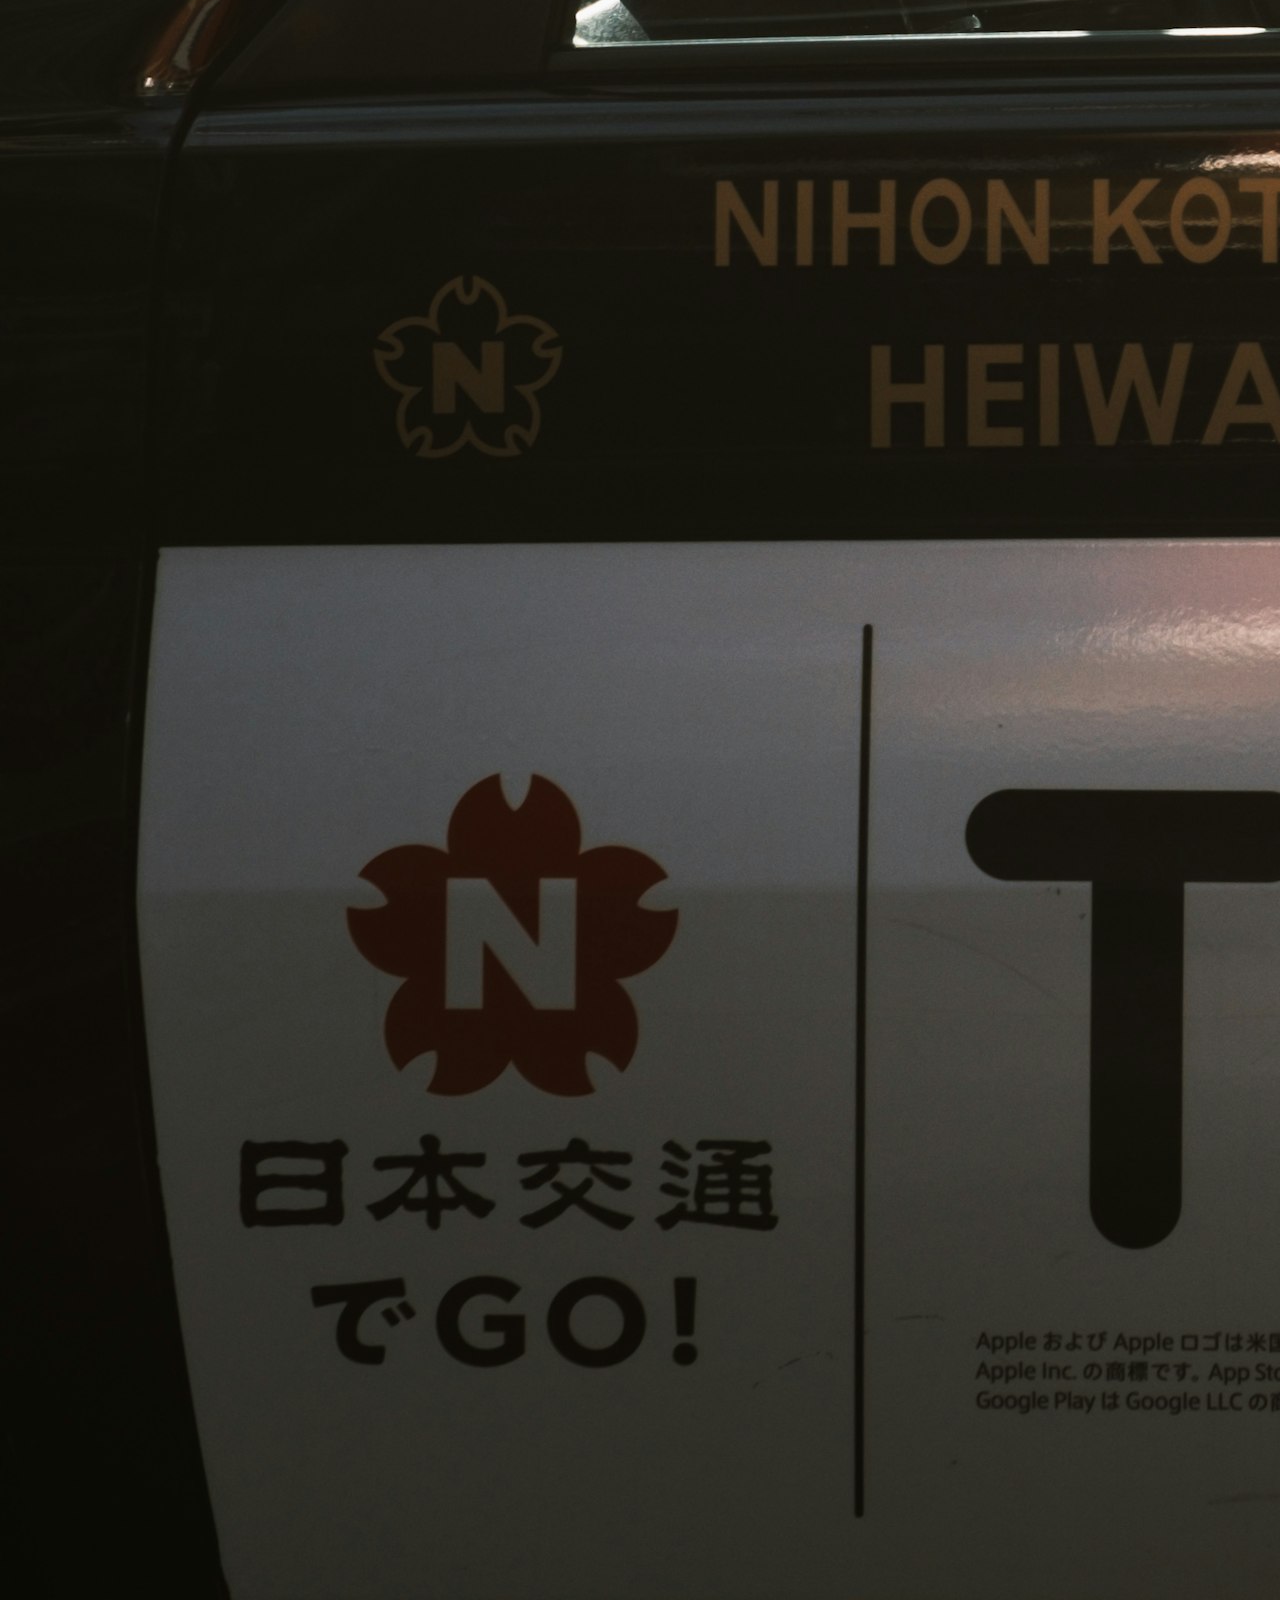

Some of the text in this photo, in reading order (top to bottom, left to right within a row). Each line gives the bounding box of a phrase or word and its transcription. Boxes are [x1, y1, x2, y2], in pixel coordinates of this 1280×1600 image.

[714, 178, 1052, 268] NIHON
[432, 341, 505, 414] N
[445, 878, 577, 1010] N
[239, 1133, 779, 1231] 日本交通
[310, 1274, 699, 1369] でGO!
[975, 1331, 1037, 1355] Apple
[1043, 1331, 1107, 1351] および
[1113, 1331, 1174, 1355] Apple
[975, 1361, 1036, 1385] Apple
[1042, 1362, 1077, 1381] Inc.
[1207, 1363, 1249, 1386] App
[975, 1391, 1049, 1415] Google
[1054, 1391, 1096, 1414] Play
[1126, 1392, 1200, 1416] Google
[1206, 1392, 1243, 1411] LLC
